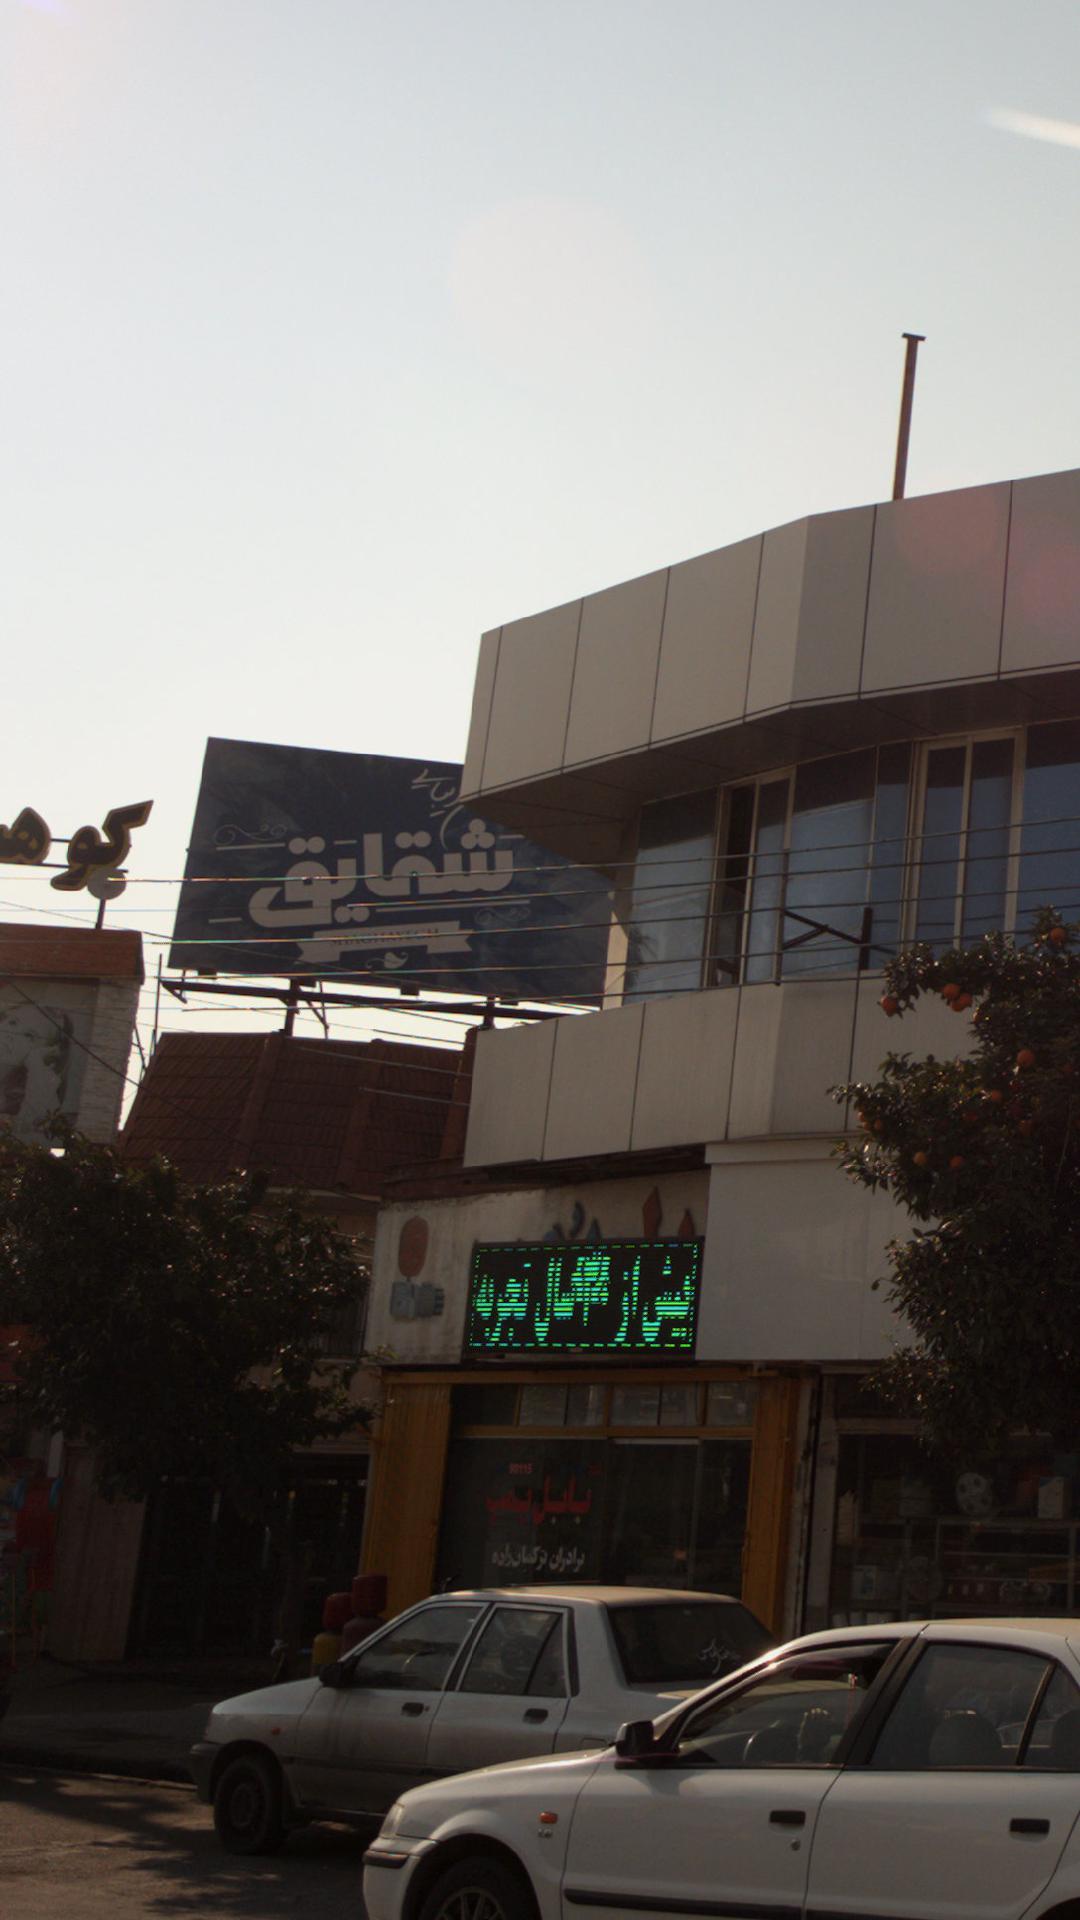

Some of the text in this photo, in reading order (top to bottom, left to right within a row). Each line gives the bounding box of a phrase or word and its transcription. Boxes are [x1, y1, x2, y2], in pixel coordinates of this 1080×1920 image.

[248, 817, 515, 929] شقایق
[533, 1256, 575, 1343] سال
[613, 1253, 641, 1343] از
